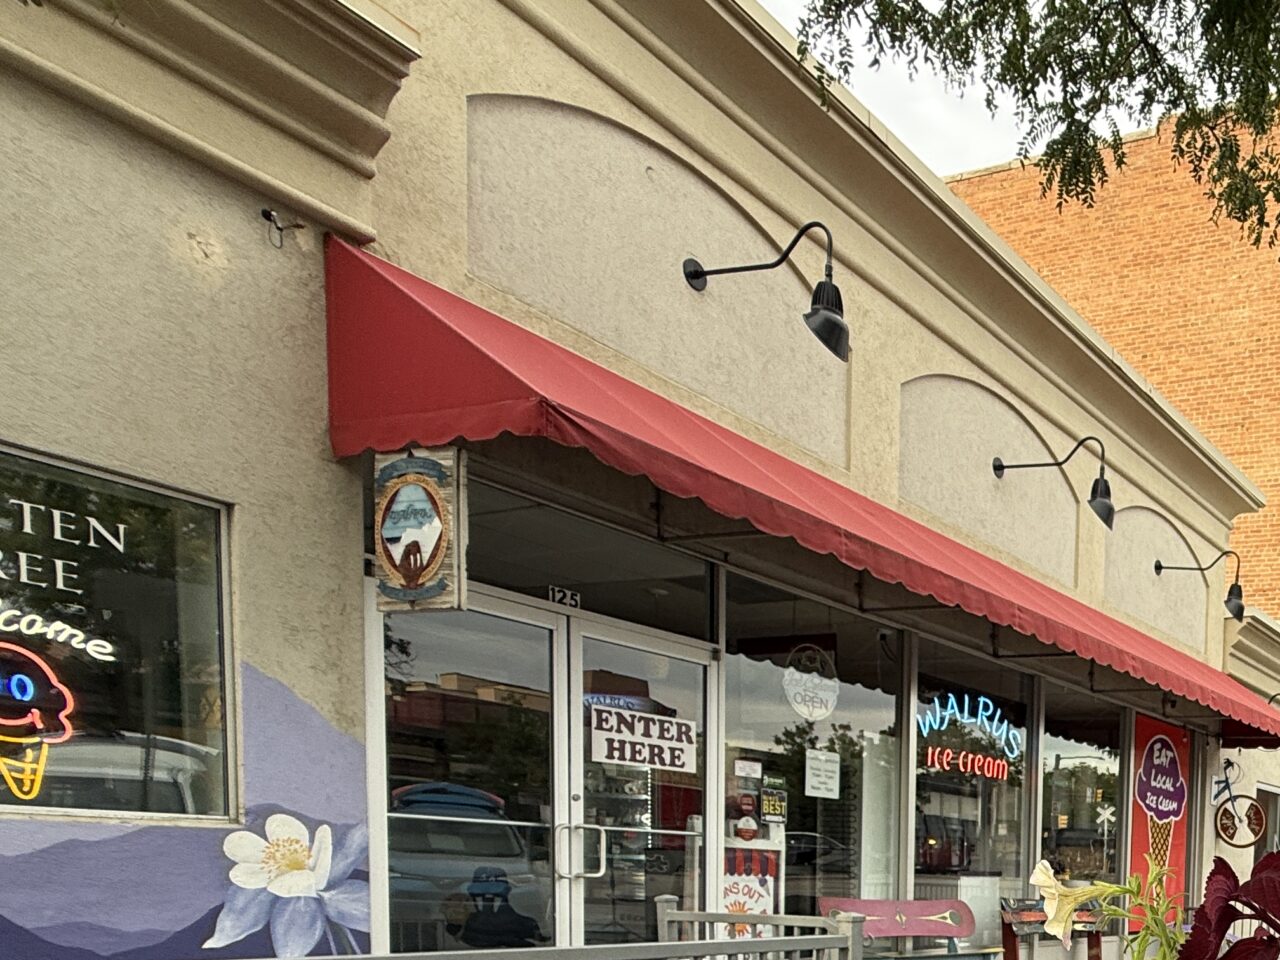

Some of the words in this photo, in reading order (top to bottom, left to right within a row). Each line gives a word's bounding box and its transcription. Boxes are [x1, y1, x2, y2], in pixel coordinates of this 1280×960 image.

[9, 499, 128, 553] TEN
[550, 587, 579, 608] 125
[0, 600, 117, 661] come
[794, 691, 829, 711] OPEN
[594, 708, 694, 745] ENTER
[916, 693, 1022, 758] WALRUS
[605, 738, 686, 769] HERE
[959, 751, 1009, 780] cream
[1153, 742, 1174, 768] EAT
[1150, 768, 1174, 792] LOCAL
[762, 800, 786, 815] BEST
[1145, 792, 1157, 808] ICE
[1158, 795, 1178, 811] CREAM
[741, 884, 764, 903] OUT
